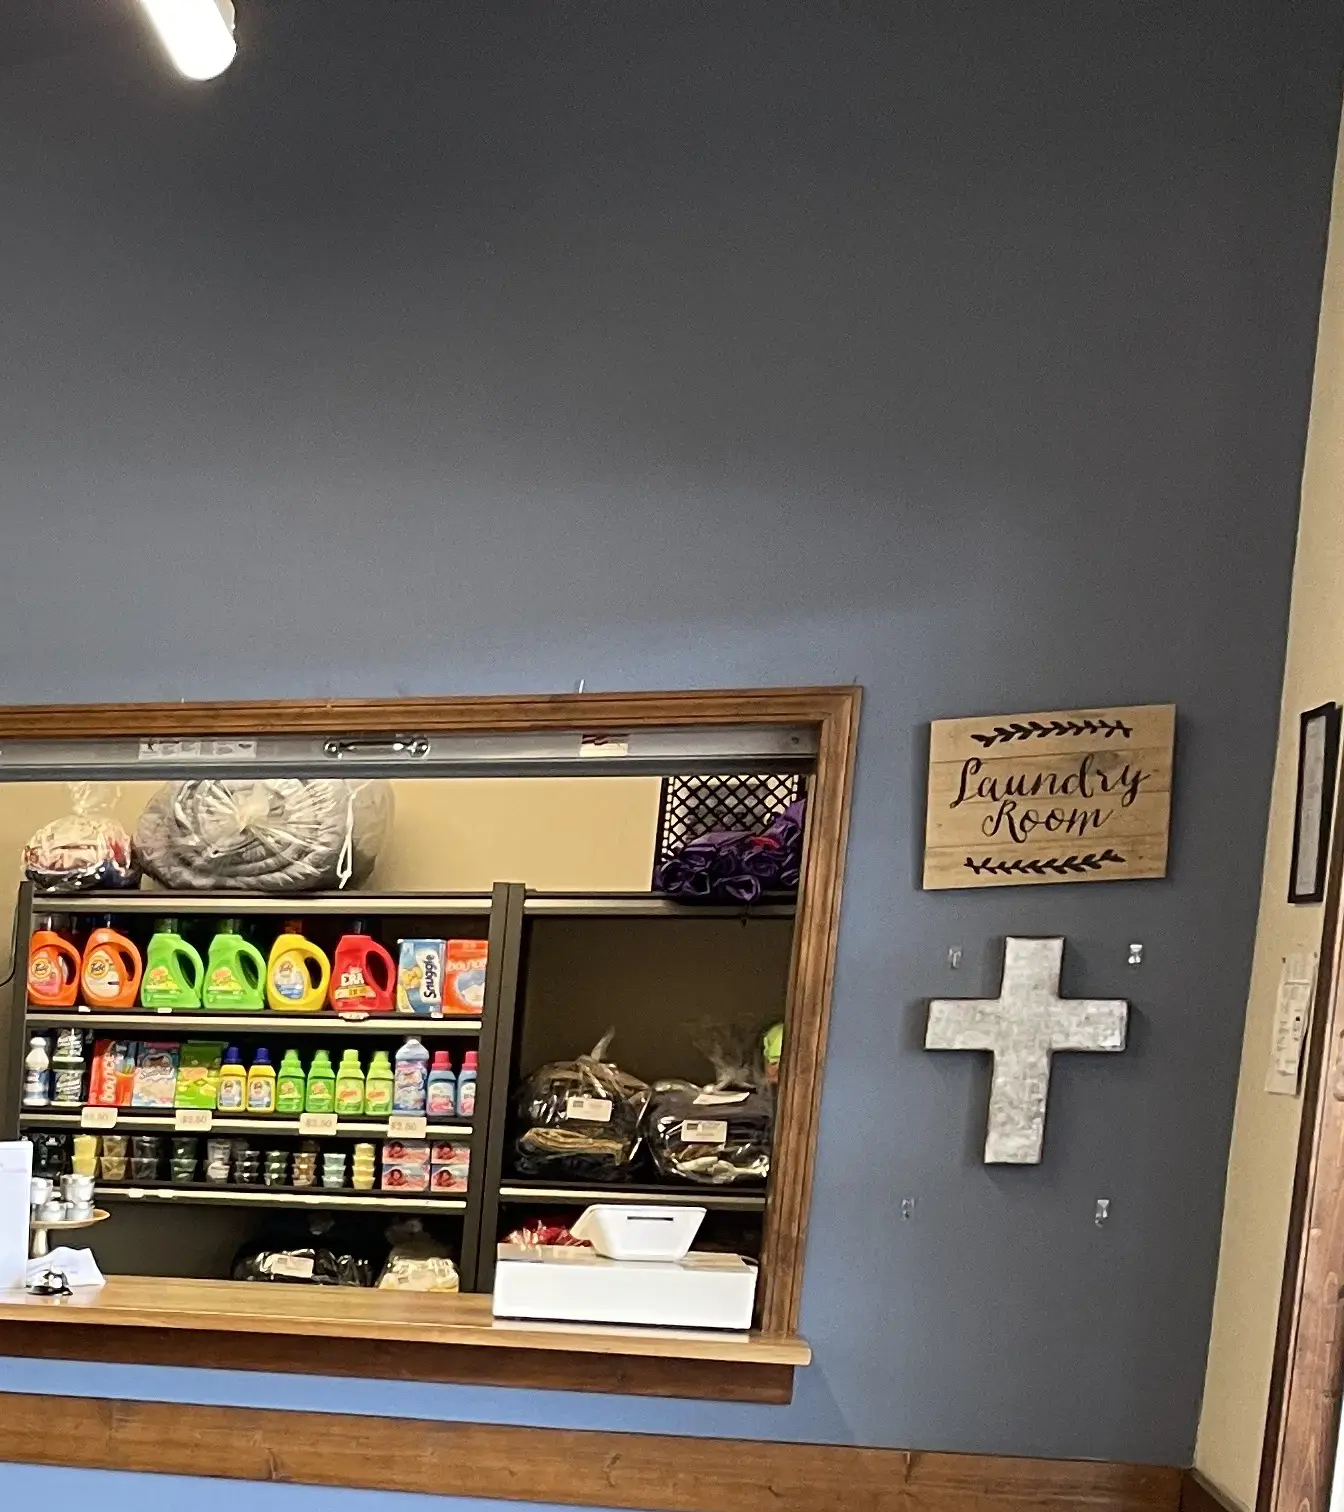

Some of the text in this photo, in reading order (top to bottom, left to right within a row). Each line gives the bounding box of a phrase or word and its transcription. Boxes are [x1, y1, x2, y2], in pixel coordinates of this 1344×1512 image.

[950, 752, 1151, 809] Laundry
[981, 799, 1114, 844] Room
[424, 954, 437, 999] Snuggle
